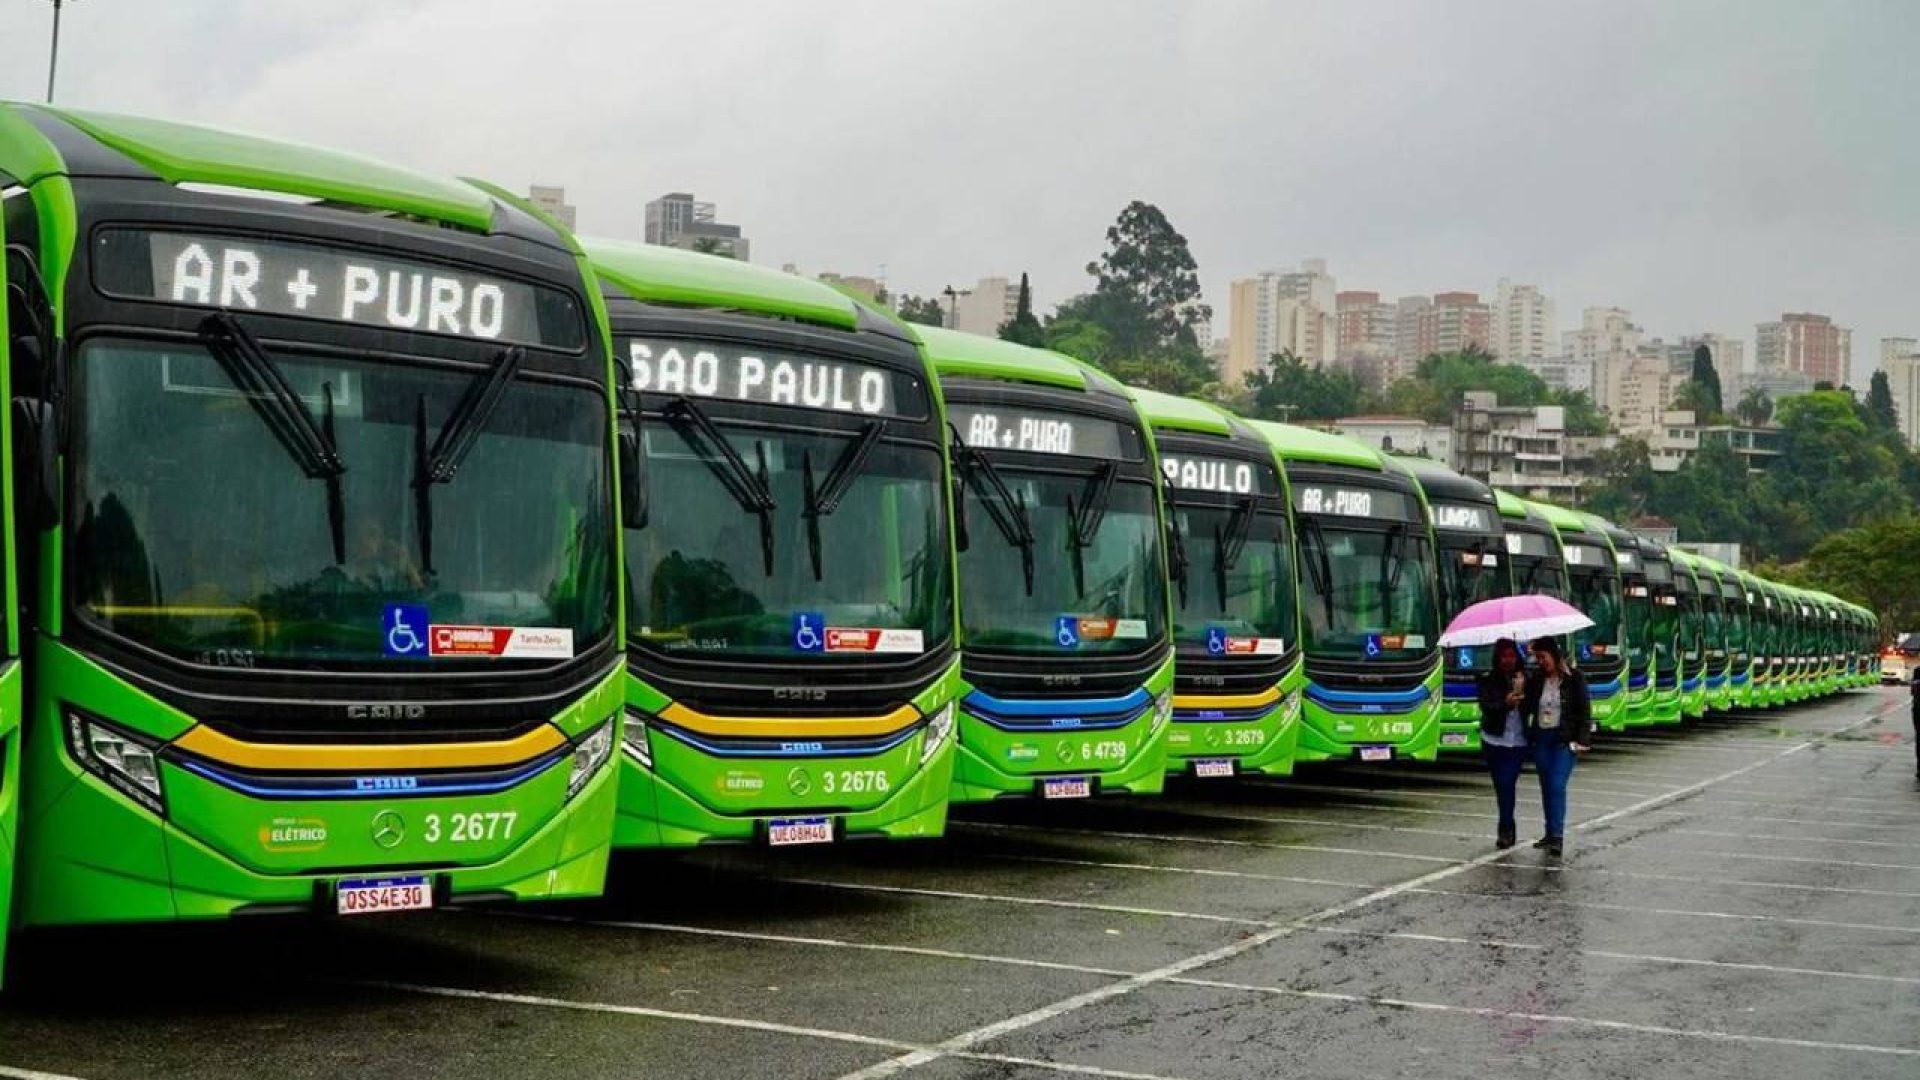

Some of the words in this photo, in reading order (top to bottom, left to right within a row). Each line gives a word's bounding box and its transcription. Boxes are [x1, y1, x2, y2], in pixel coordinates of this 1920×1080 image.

[173, 244, 260, 308] AR
[287, 270, 316, 308] +
[342, 264, 504, 339] PURO
[739, 357, 885, 413] PAULO
[969, 414, 997, 447] AR
[1002, 429, 1014, 447] +
[1019, 416, 1072, 453] PURO
[1163, 458, 1251, 493] PAULO
[1302, 488, 1323, 512] AR
[1324, 498, 1333, 512] +
[1335, 490, 1371, 516] PURO
[1439, 506, 1480, 529] LIMPA
[1082, 743, 1091, 759] 6
[1224, 729, 1233, 744] 3
[823, 771, 834, 792] 3
[841, 770, 888, 793] 2676
[425, 814, 441, 842] 3
[450, 812, 518, 841] 2677
